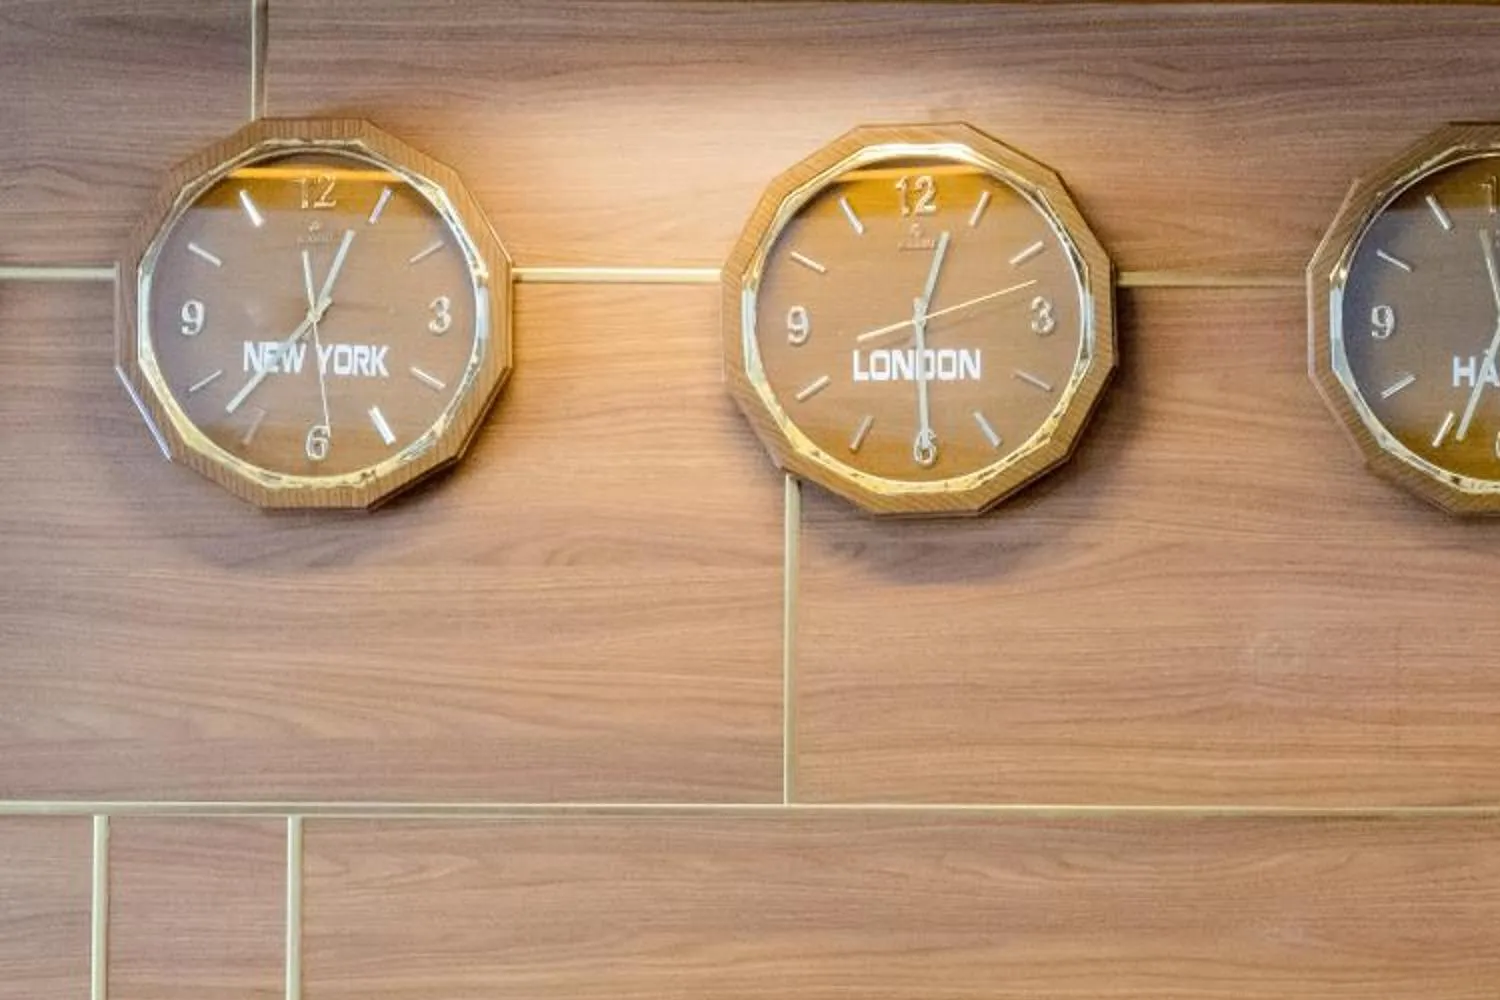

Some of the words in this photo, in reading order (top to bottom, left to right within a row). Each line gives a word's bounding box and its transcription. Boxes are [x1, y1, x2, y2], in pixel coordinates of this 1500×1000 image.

[298, 176, 337, 208] 12
[896, 176, 936, 215] 12
[181, 300, 204, 335] 9
[428, 297, 451, 333] 3
[786, 307, 810, 344] 9
[1031, 297, 1055, 335] 3
[1371, 305, 1395, 339] 9
[244, 340, 306, 373] NEW
[315, 343, 390, 377] YORK
[852, 349, 982, 381] LONDON
[306, 425, 331, 460] 6
[913, 429, 937, 465] 6
